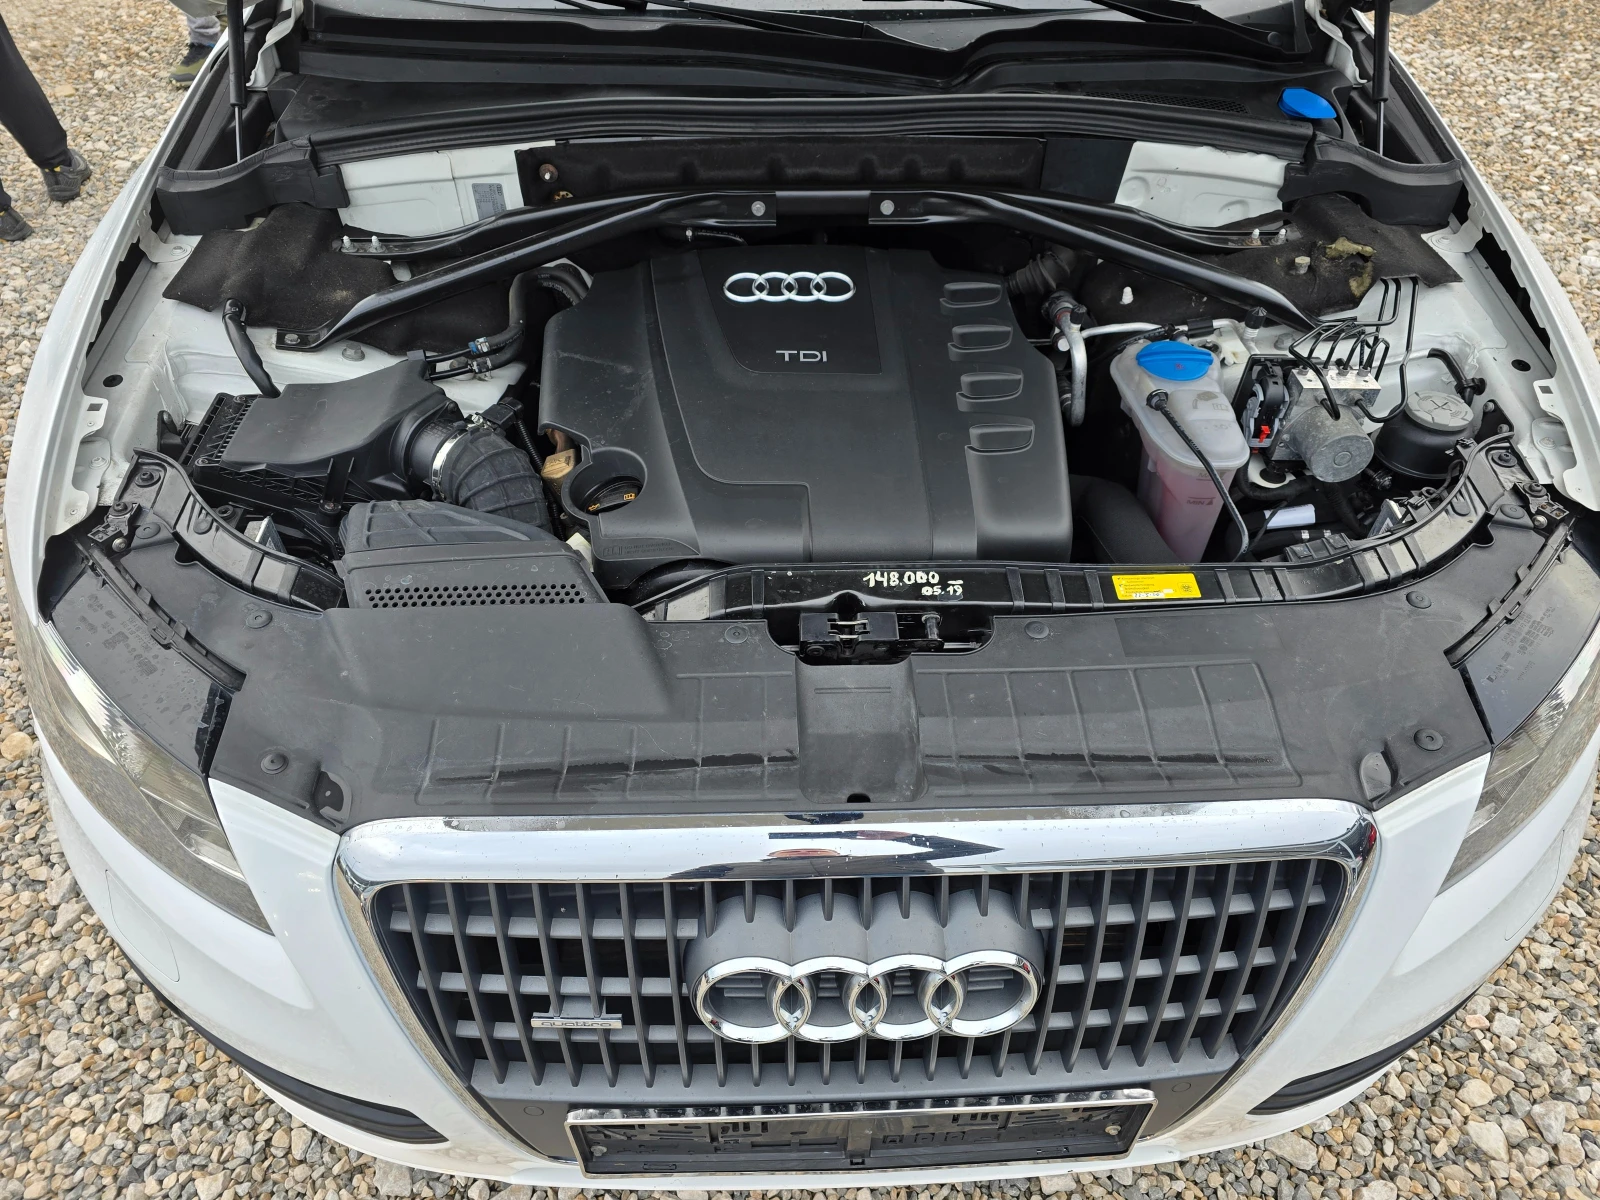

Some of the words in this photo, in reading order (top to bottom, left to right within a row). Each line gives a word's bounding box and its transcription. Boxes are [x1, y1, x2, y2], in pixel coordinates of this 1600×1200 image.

[775, 350, 828, 362] TDI
[862, 570, 940, 588] 148.000
[921, 585, 963, 596] 05.19
